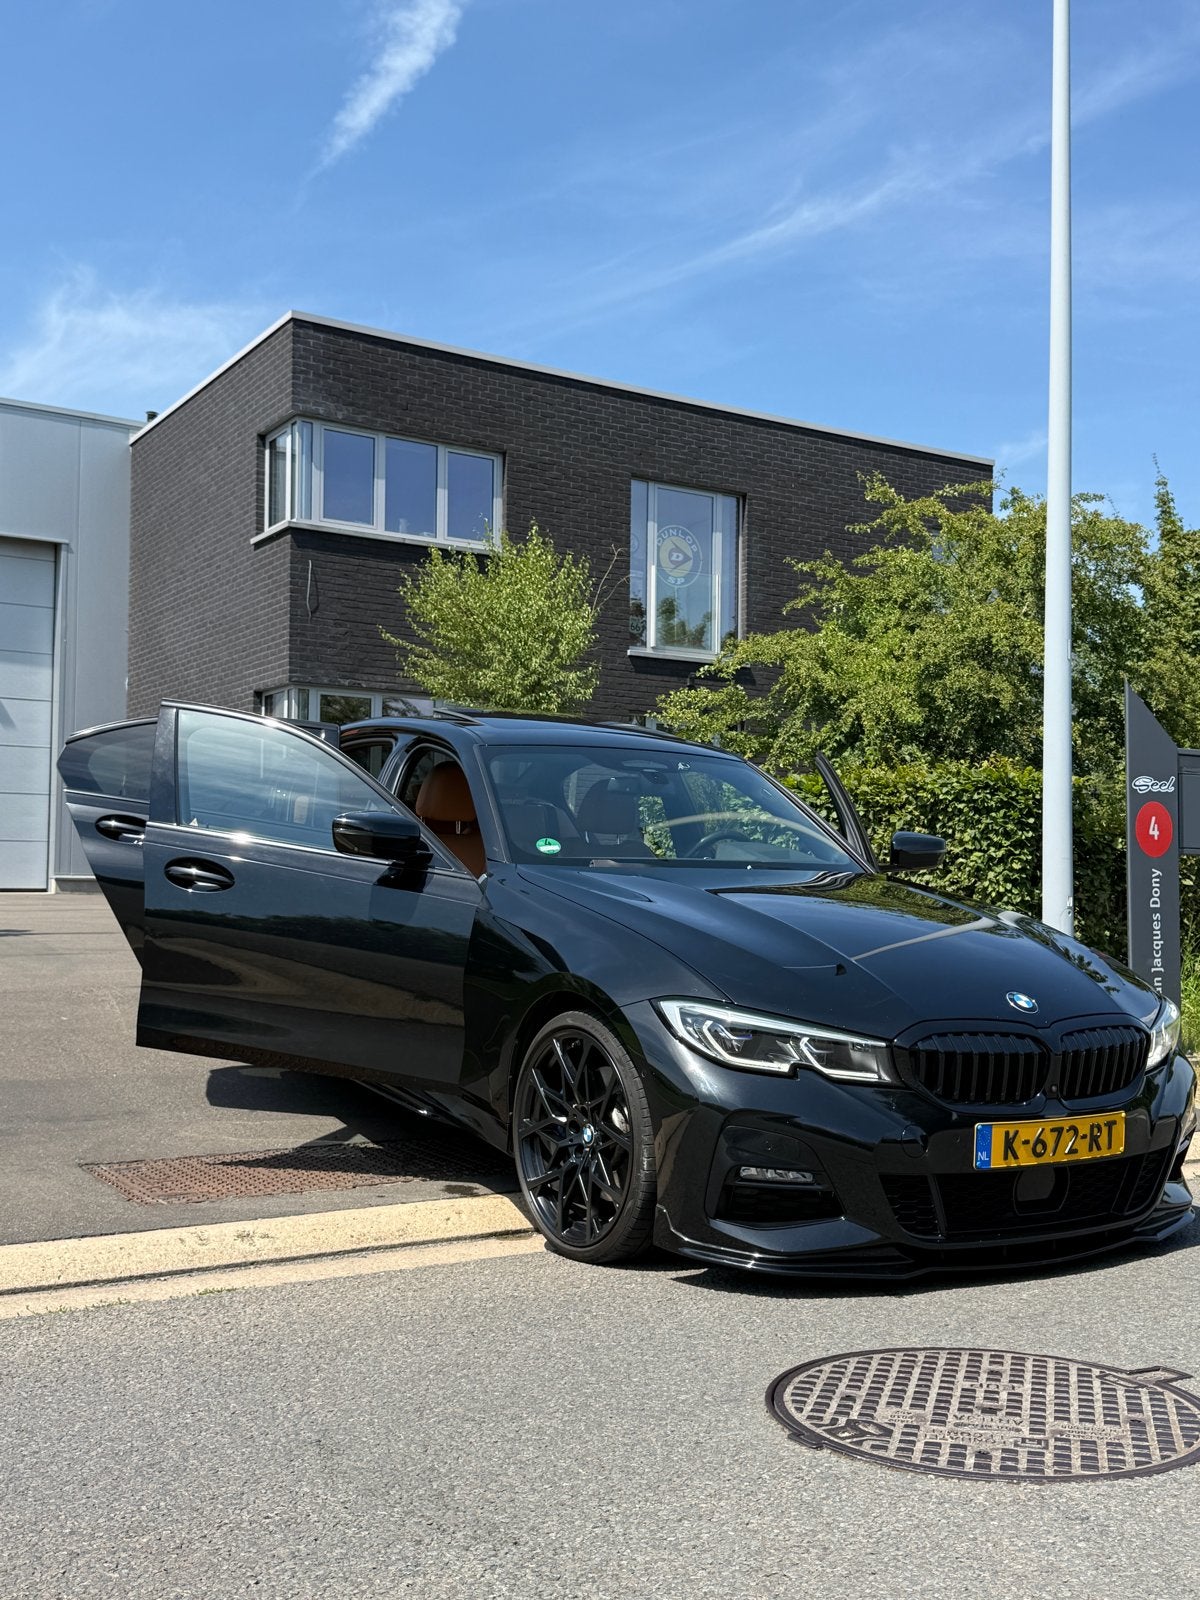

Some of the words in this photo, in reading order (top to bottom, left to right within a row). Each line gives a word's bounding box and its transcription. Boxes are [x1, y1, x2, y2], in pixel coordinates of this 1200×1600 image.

[656, 528, 698, 552] DUNLOP
[1149, 815, 1160, 841] 4
[1149, 868, 1163, 908] Dony
[1152, 913, 1164, 973] Jacques
[977, 1151, 990, 1161] NL
[1003, 1120, 1118, 1161] K-672-RT
